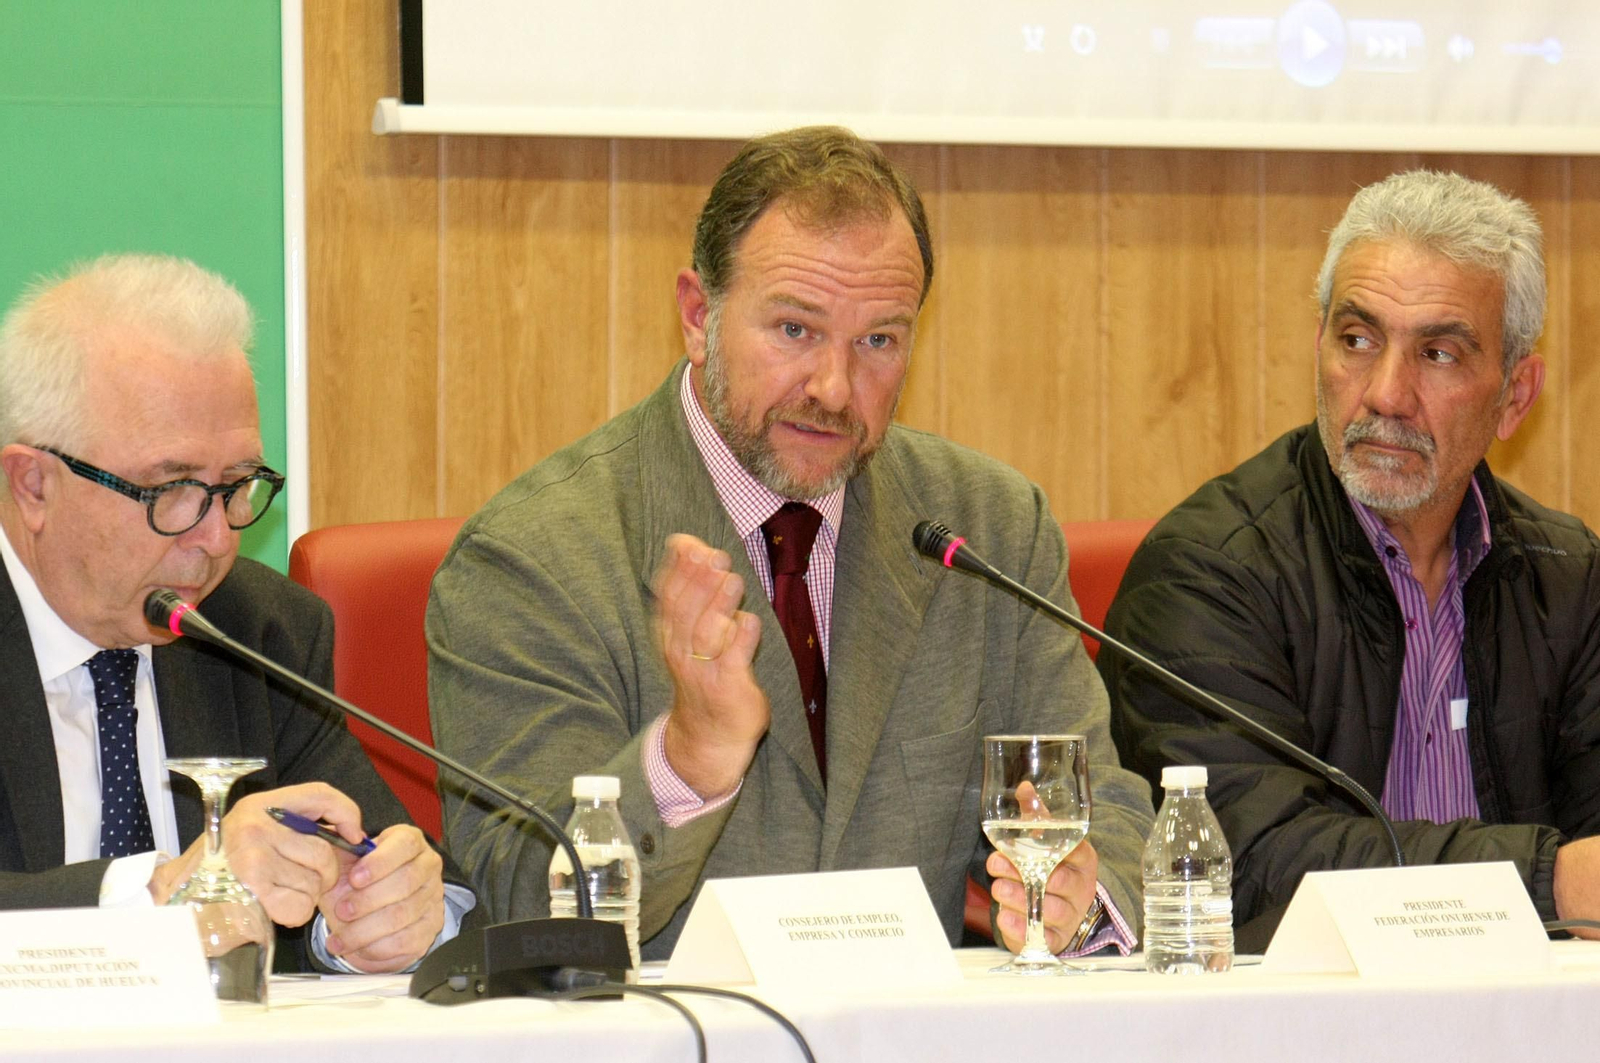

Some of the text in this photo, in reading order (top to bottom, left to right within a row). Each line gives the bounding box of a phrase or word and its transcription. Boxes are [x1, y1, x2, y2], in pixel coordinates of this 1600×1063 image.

[1403, 899, 1466, 911] PRESIDENTE
[778, 913, 903, 928] CONSEJERO DE EMPLEO,
[1373, 910, 1511, 926] FEDERACIÓN ONUBENSE DE
[788, 927, 904, 941] EMPRESA Y COMERCIO
[1413, 926, 1485, 938] EMPRESARIOS
[521, 933, 605, 957] BOSCH
[18, 947, 106, 959] PRESIDENTE
[75, 976, 95, 988] DE
[99, 975, 160, 987] HUELVA
